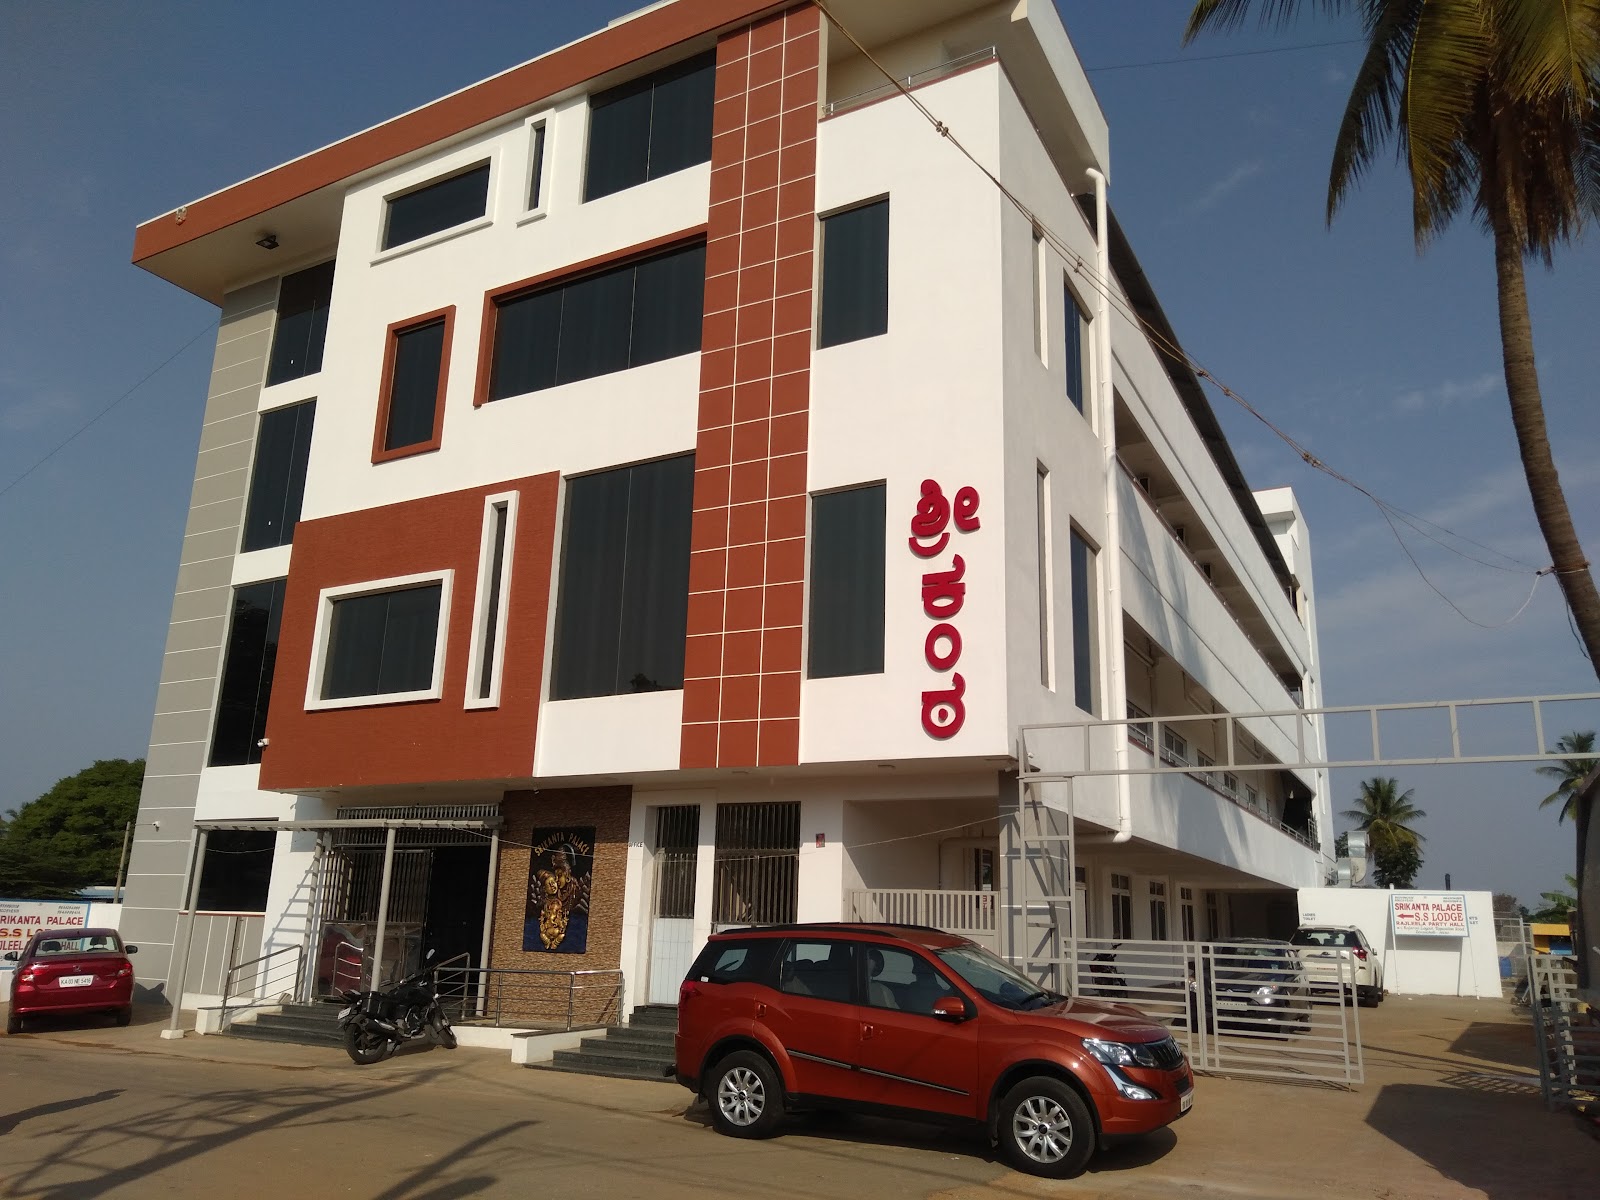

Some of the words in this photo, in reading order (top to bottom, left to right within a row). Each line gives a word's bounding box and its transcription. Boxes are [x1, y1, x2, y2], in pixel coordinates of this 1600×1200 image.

[534, 832, 565, 857] SRIKANTA
[568, 832, 590, 856] PALACE
[1394, 903, 1430, 911] SRIKANTA
[1432, 904, 1462, 912] PALACE
[0, 916, 41, 925] RIKANTA
[46, 916, 84, 926] PALACE
[1414, 912, 1429, 921] S.S
[1432, 912, 1464, 922] LODGE
[0, 940, 24, 950] JLEEL
[61, 941, 80, 950] HALL
